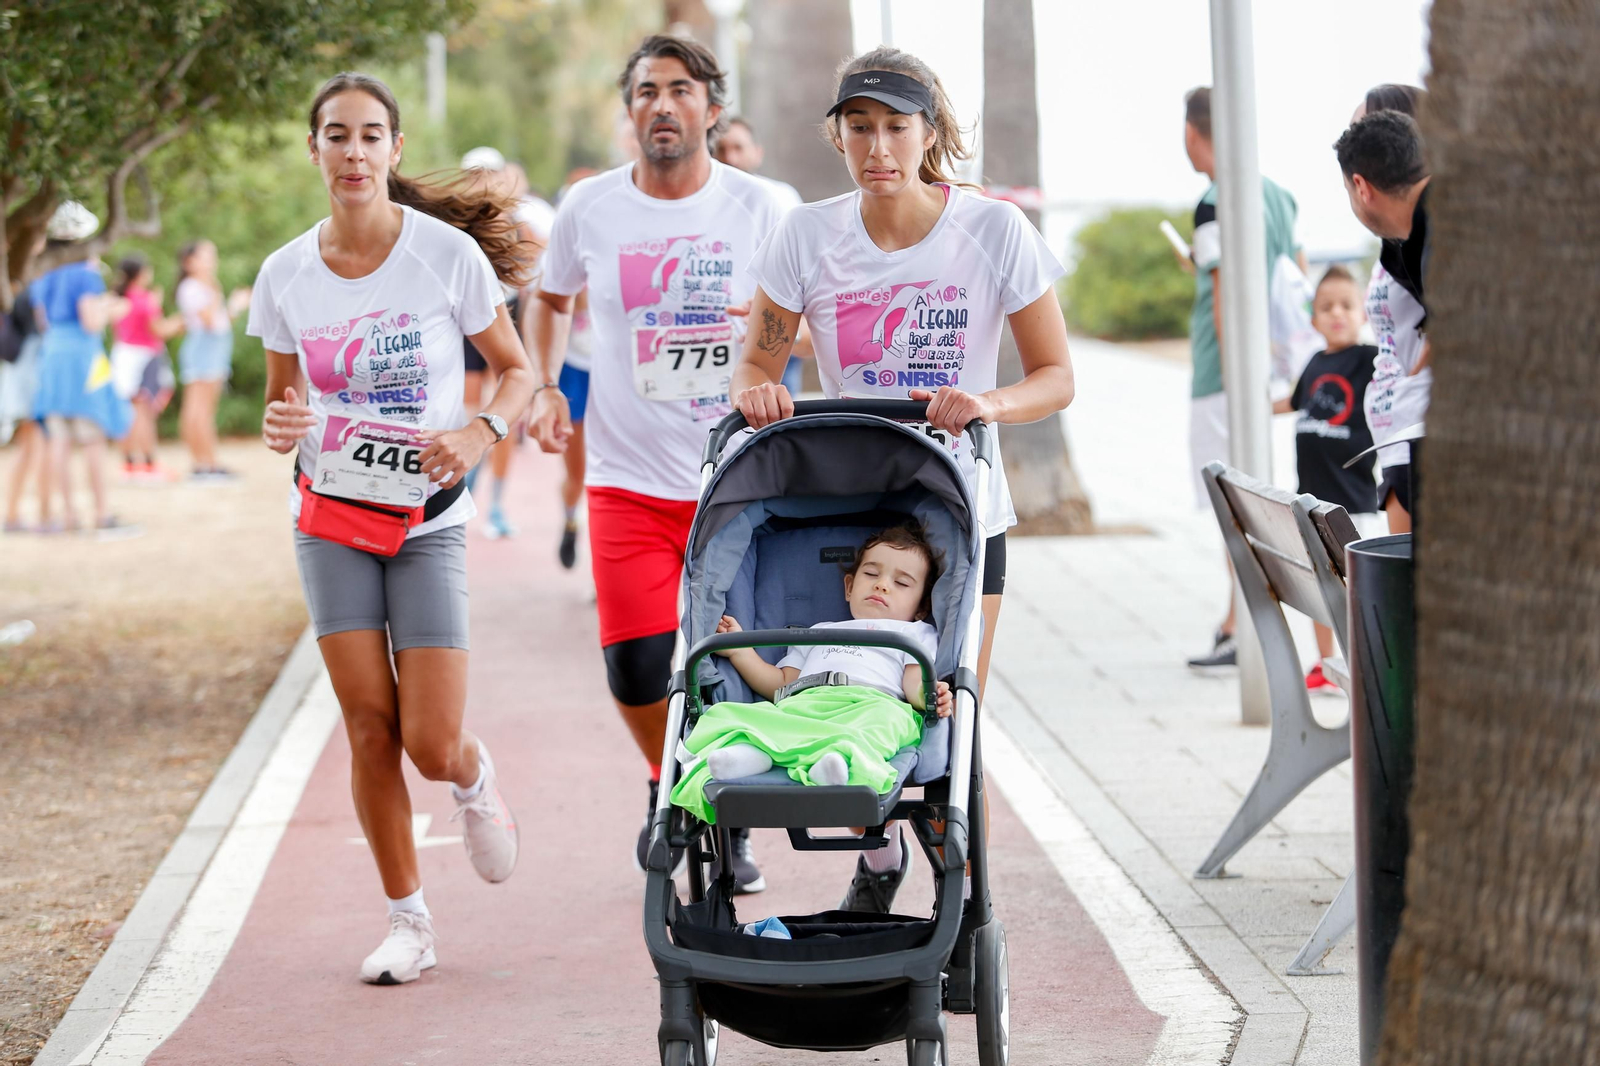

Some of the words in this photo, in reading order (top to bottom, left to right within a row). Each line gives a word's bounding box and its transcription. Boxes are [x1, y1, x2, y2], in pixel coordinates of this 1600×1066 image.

[836, 289, 890, 302] valores
[914, 285, 967, 310] AMOR
[300, 323, 348, 338] valores
[371, 313, 420, 339] AMOR
[667, 345, 729, 370] 779
[908, 347, 965, 360] FUERZA
[371, 368, 428, 382] FUERZA
[862, 370, 959, 387] SONRISA
[338, 387, 428, 404] SONRISA
[352, 442, 424, 475] 446
